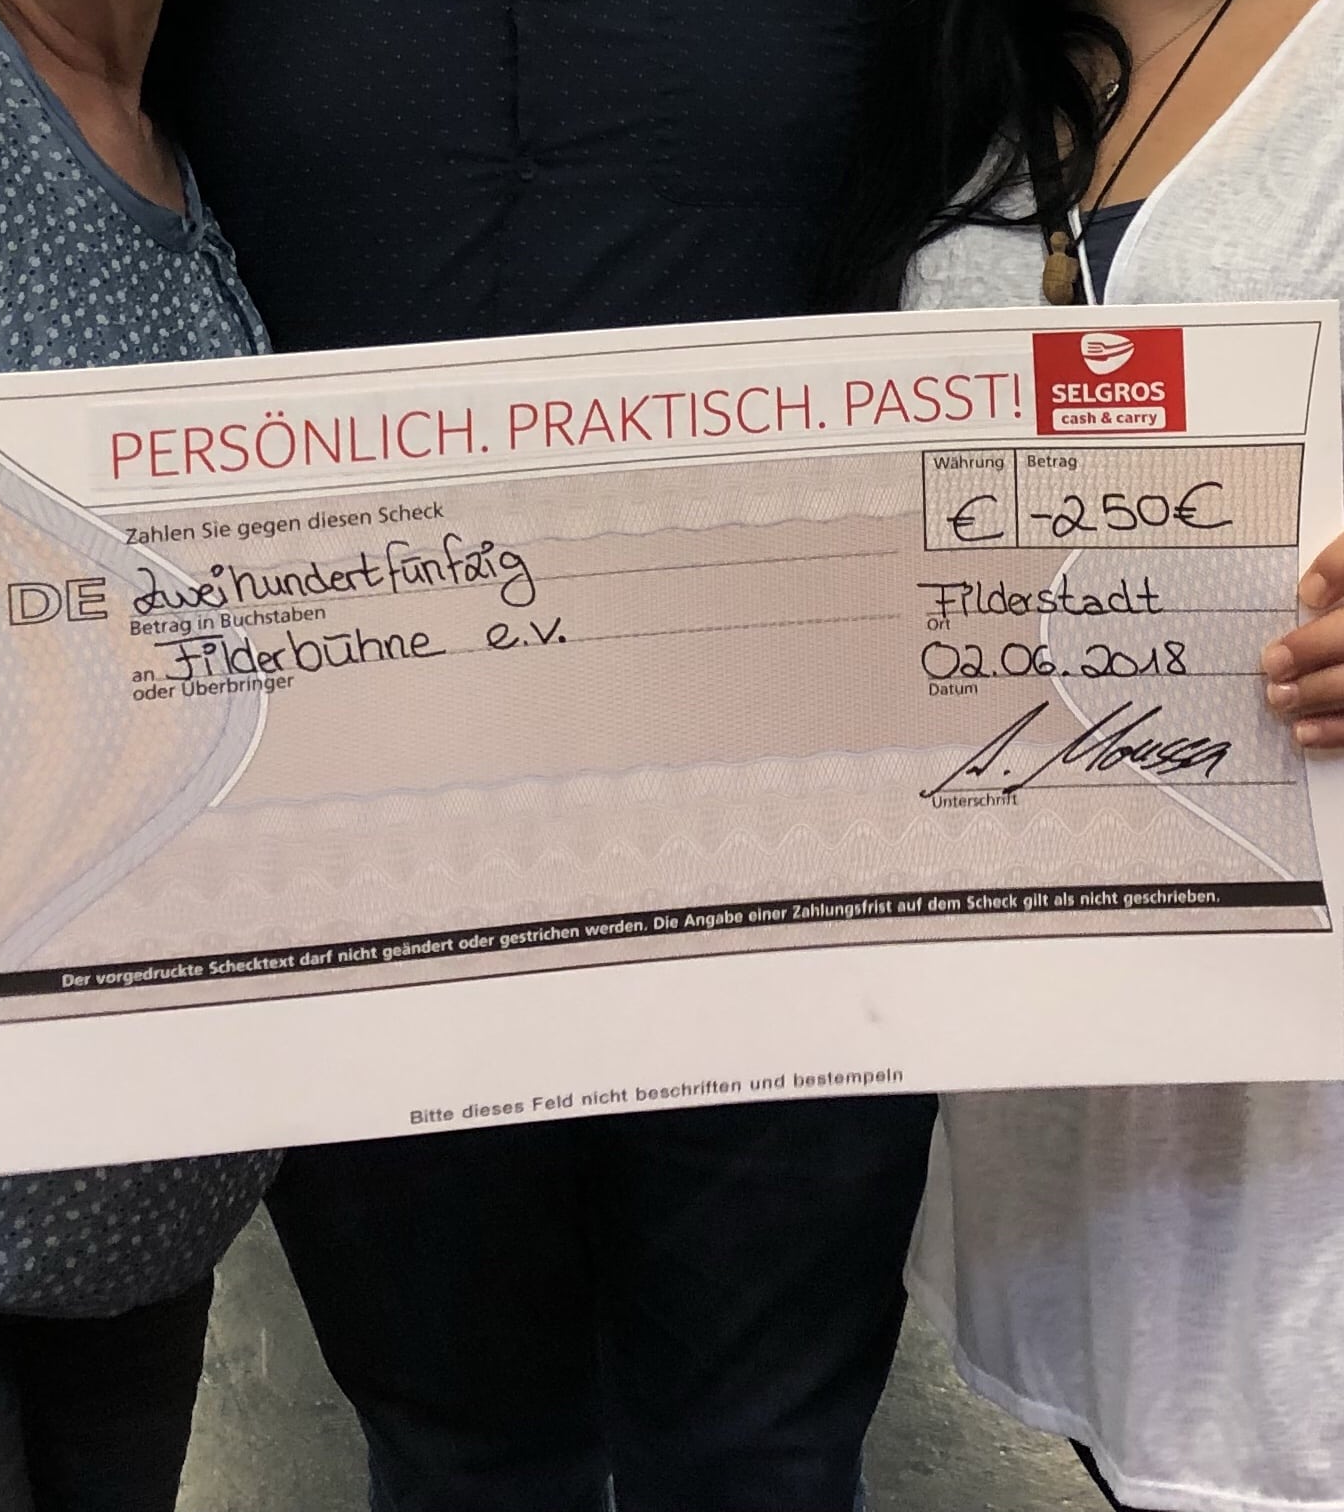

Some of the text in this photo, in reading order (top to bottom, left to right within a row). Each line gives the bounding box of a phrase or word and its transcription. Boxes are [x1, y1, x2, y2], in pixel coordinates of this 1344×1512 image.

[1050, 380, 1167, 405] SELGROS
[111, 372, 1023, 480] PERSÖNLICH. PRAKTISCH. PASST!
[1060, 411, 1159, 429] cash & carry
[932, 454, 1078, 475] Währung Betrag
[125, 501, 445, 546] Zahlen Sie gegen diesen Scheck
[7, 576, 110, 627] DE
[916, 575, 1164, 619] Filderstadt
[129, 605, 327, 640] Betrag in Buchstaben
[926, 615, 952, 632] Ort
[920, 639, 1189, 681] 02.06.2018
[131, 668, 156, 684] an
[927, 682, 980, 698] Datum
[132, 683, 176, 702] oder
[930, 791, 1019, 811] Unterschrift
[61, 889, 1221, 989] Der vorgedruckte Schecktext darf nicht geändert oder gestrichen werden. Die Angabe einer Zahlungsfrist auf dem Scheck gilt als nicht geschrieben.
[409, 1067, 905, 1126] Bitte dieses Feld nicht beschriften und bestempeln
